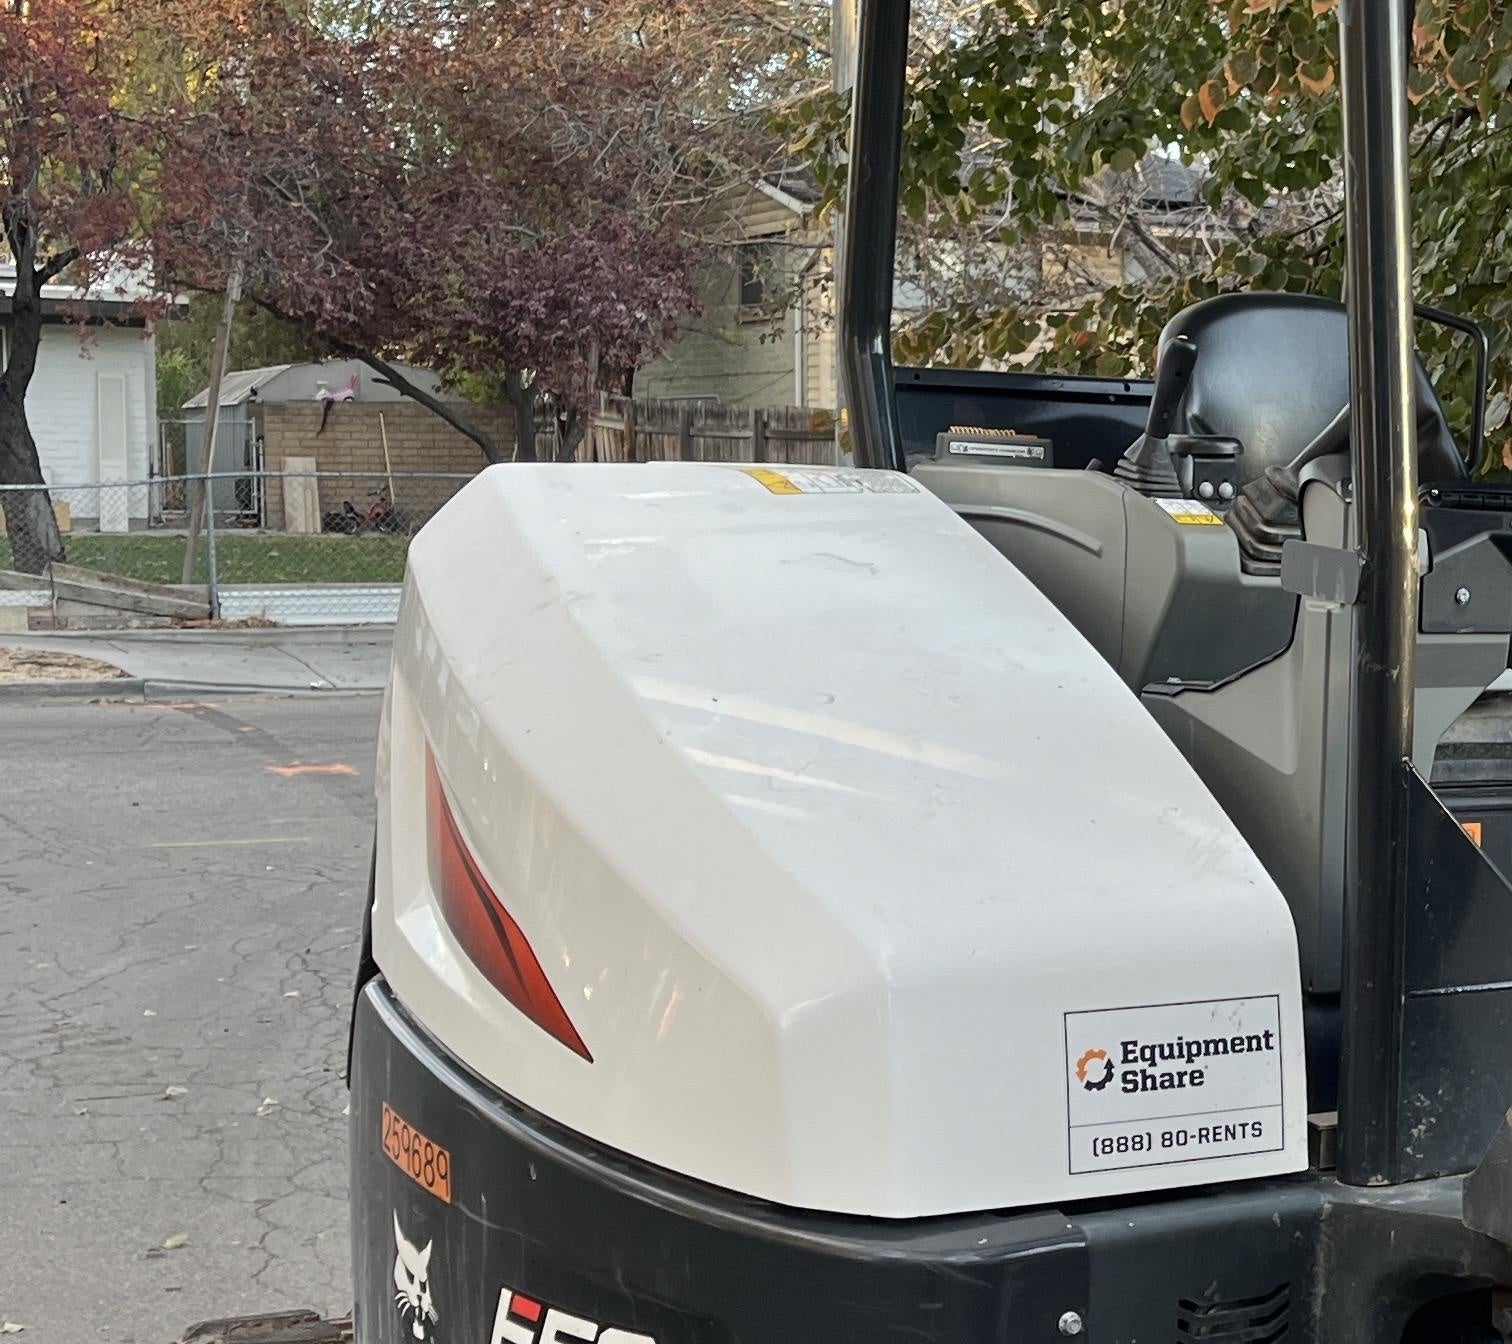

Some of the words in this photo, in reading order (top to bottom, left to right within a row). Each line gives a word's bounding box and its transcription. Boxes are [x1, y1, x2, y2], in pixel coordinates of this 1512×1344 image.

[1120, 1029, 1275, 1067] Equipment
[1120, 1068, 1206, 1094] Share
[383, 1106, 450, 1198] 259689
[1092, 1132, 1152, 1157] (888)
[1160, 1121, 1263, 1149] 80-RENTS
